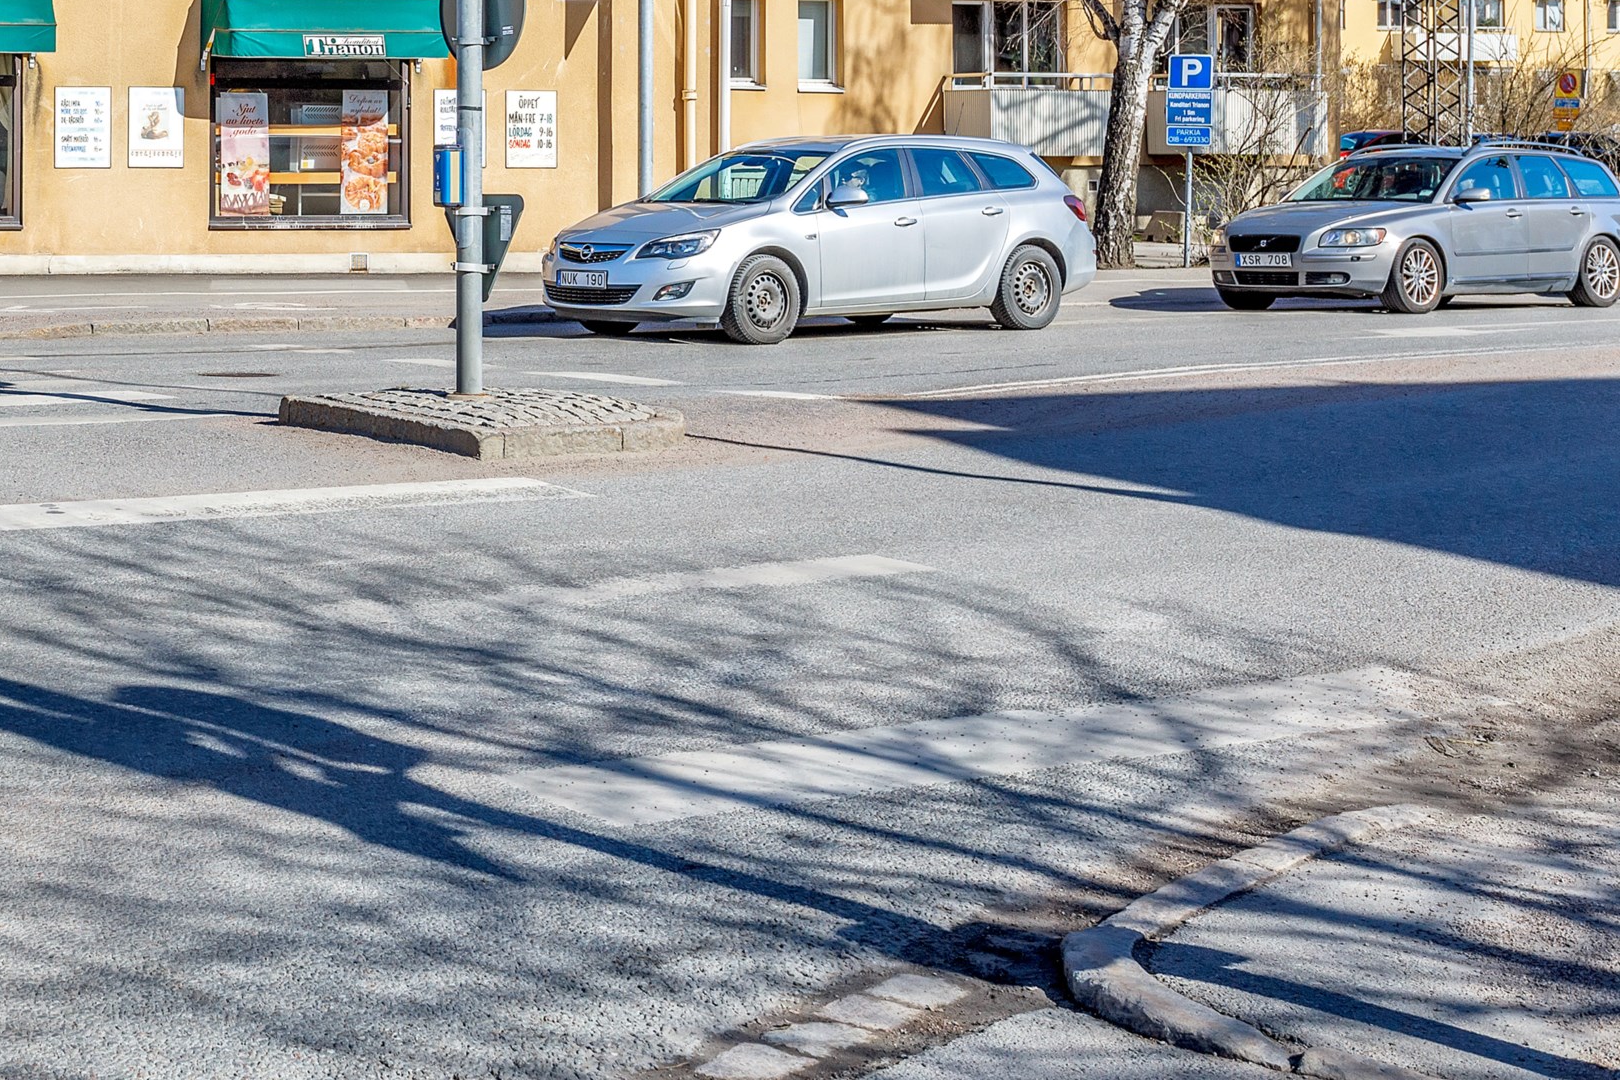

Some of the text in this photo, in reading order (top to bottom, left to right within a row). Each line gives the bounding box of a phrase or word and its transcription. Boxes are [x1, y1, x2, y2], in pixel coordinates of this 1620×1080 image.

[305, 37, 384, 55] Trianon
[1182, 59, 1203, 87] P
[349, 94, 373, 107] Doften
[518, 95, 540, 109] ÖPPET
[1168, 92, 1211, 100] KUNDPARKERING
[232, 103, 257, 116] Njut
[238, 116, 264, 125] livets
[508, 111, 553, 124] MÅN-FRE 7-18
[230, 127, 257, 138] goda
[508, 125, 553, 137] LÖRDAG 9-16
[508, 137, 553, 149] SÖNDAG 10-16
[1242, 254, 1287, 265] XSR 708
[561, 272, 603, 286] NUK 190
